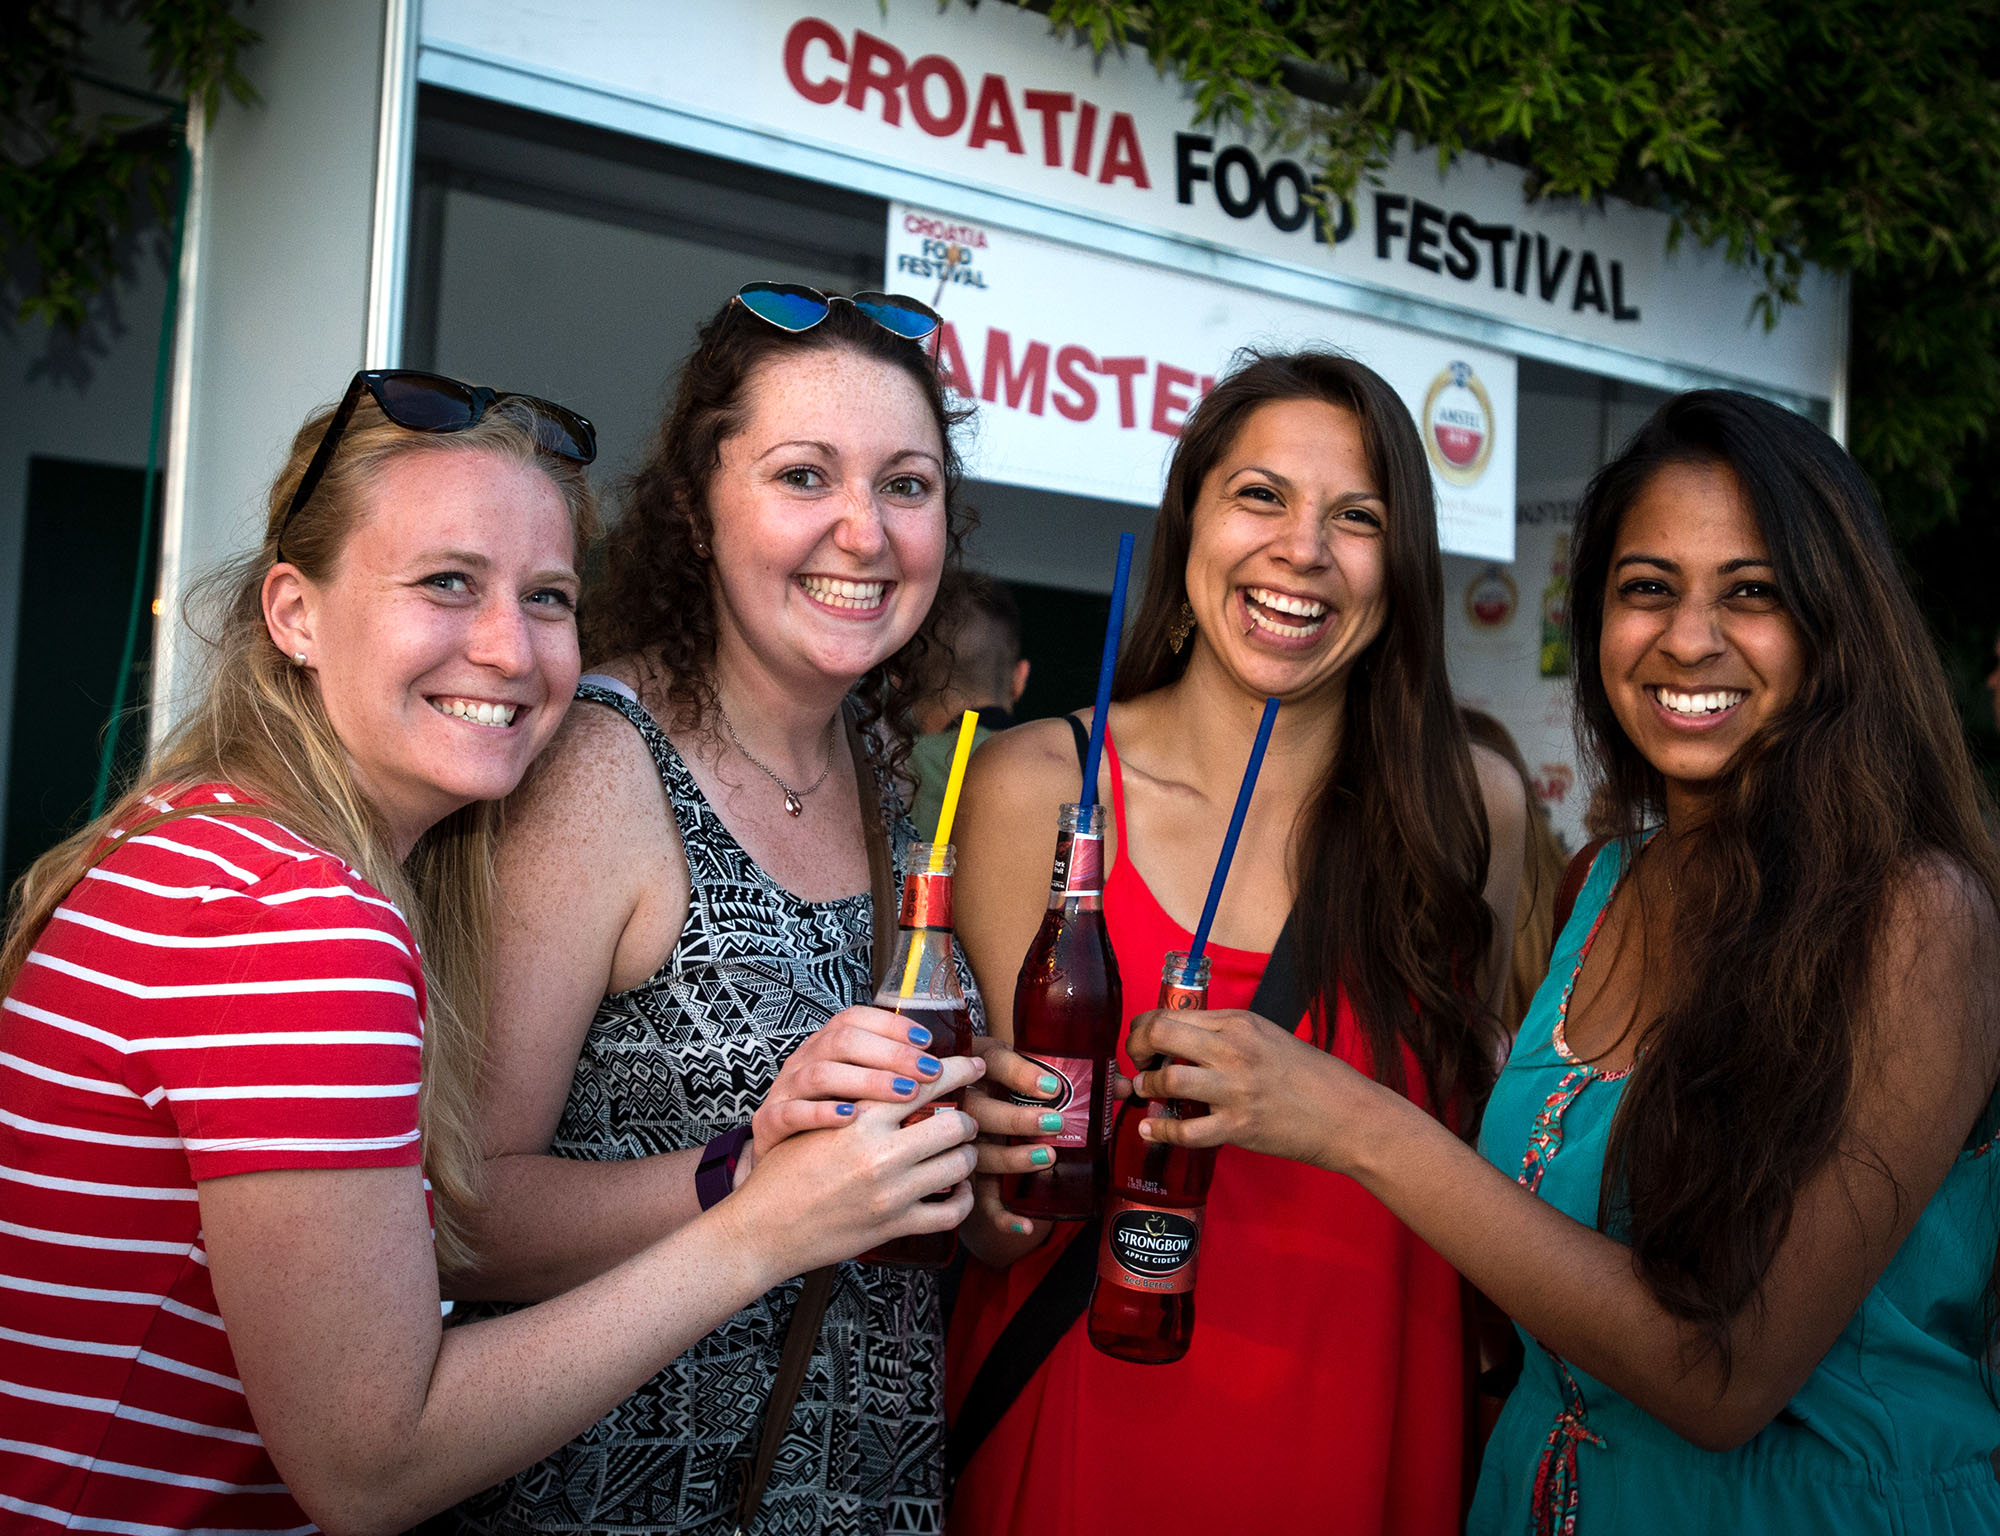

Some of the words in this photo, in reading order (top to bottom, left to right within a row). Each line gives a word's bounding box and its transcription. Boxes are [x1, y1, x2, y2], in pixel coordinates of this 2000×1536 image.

[783, 16, 1152, 190] CROATIA
[1373, 192, 1641, 322] FESTIVAL
[904, 214, 988, 248] CROATIA
[898, 254, 989, 288] FESTIVAL
[927, 320, 1216, 439] AMSTE
[1118, 1230, 1190, 1252] STRONGBOW
[1125, 1250, 1149, 1263] APPLE
[1152, 1255, 1181, 1264] CIDERS
[1123, 1274, 1141, 1286] Red
[1143, 1279, 1174, 1290] Berries
